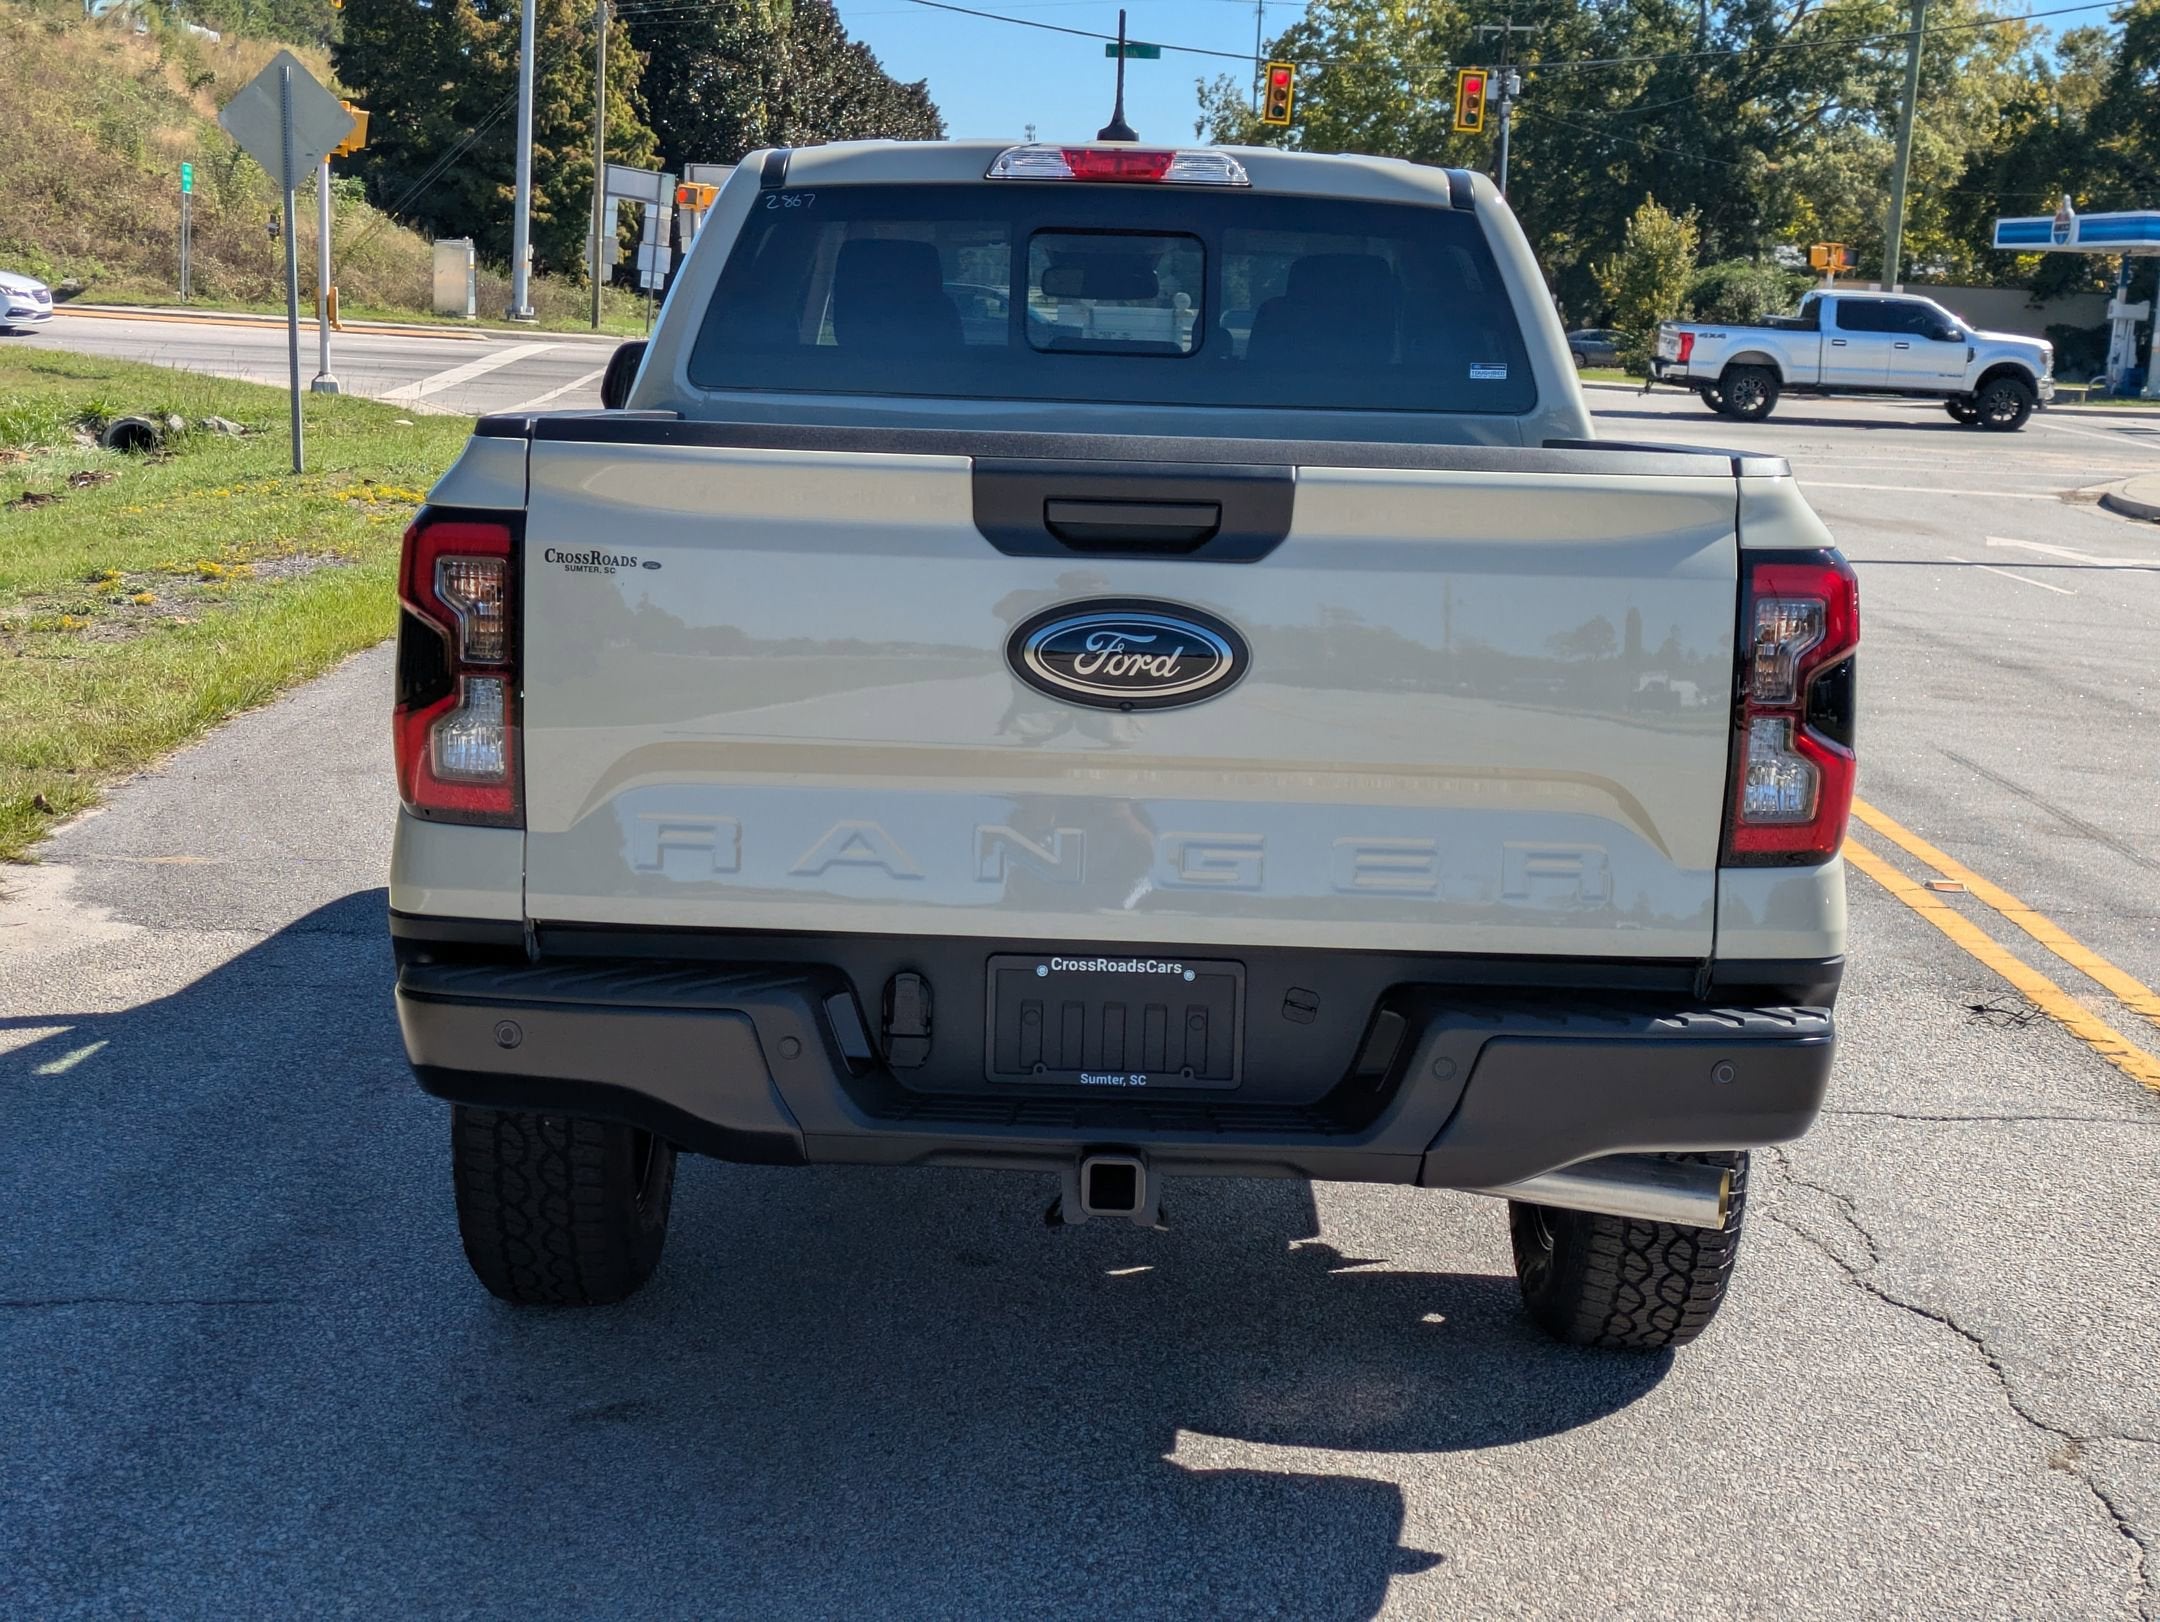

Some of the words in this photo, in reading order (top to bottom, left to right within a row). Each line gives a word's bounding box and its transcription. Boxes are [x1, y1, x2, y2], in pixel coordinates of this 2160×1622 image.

[766, 194, 816, 209] 2867
[1073, 630, 1185, 678] Ford
[634, 811, 1614, 904] RANGER
[1050, 957, 1183, 975] CrossRoadsCars
[1080, 1073, 1127, 1087] Sumter,
[1129, 1074, 1147, 1086] SC
